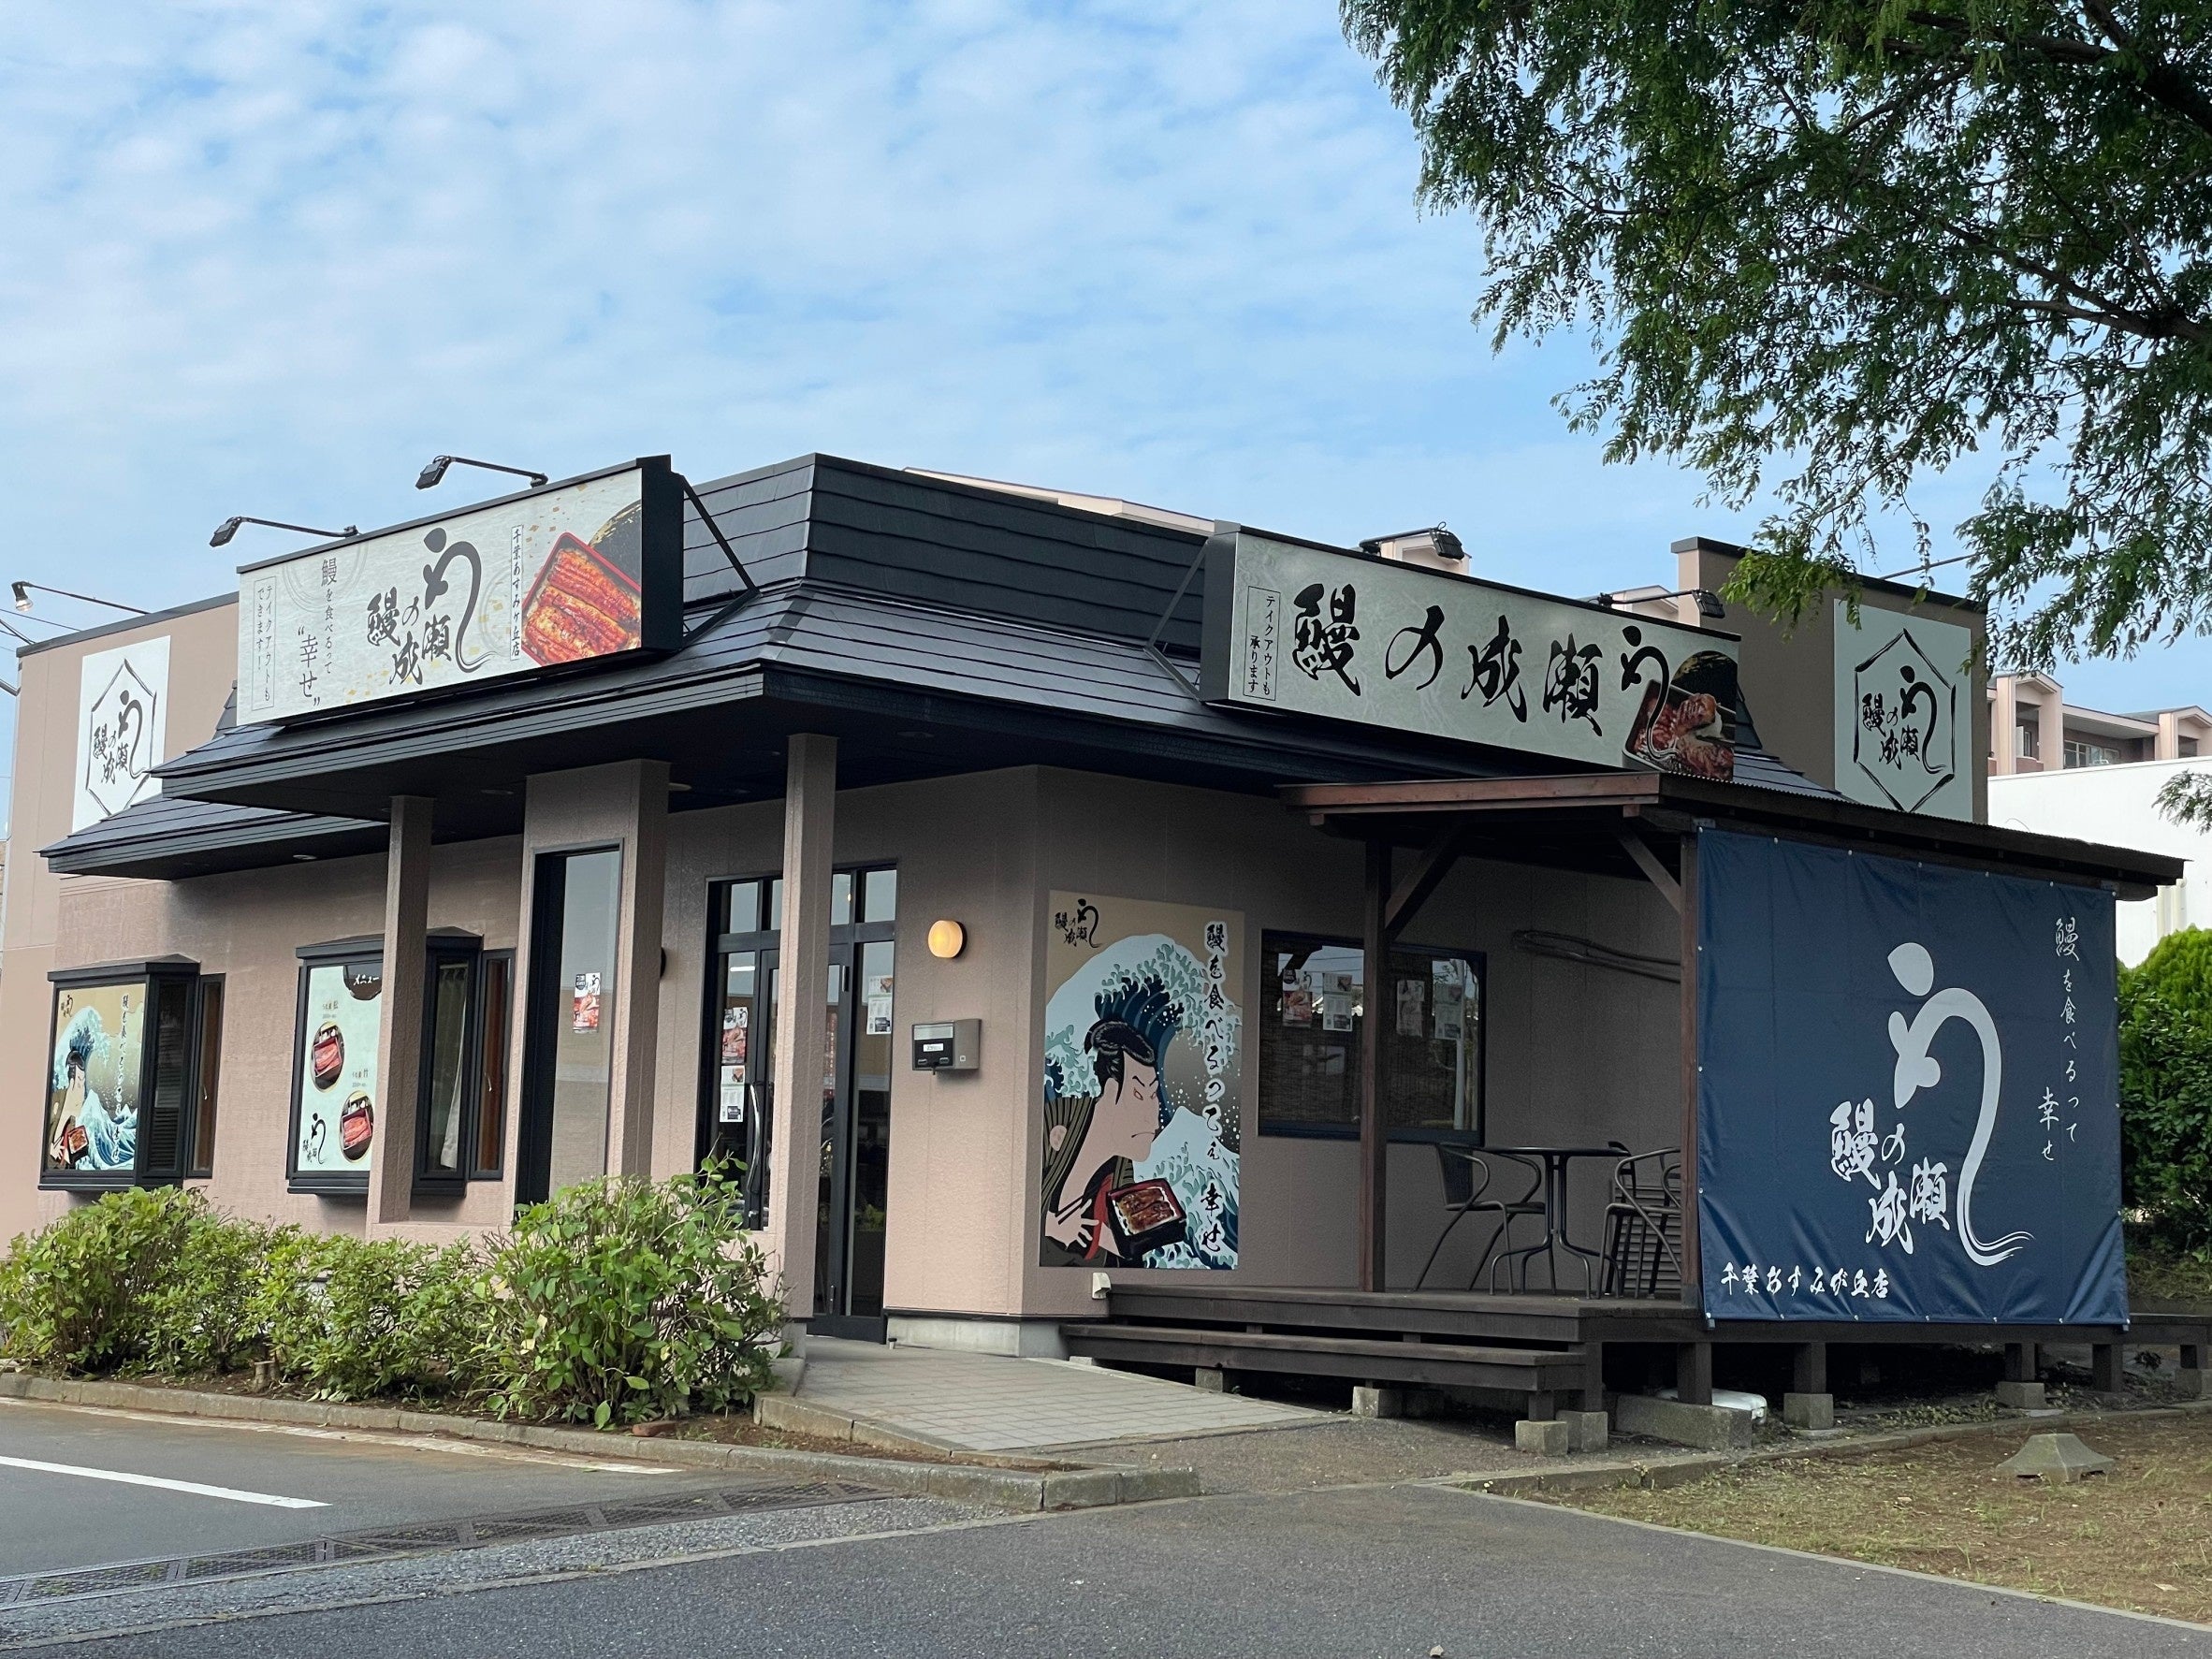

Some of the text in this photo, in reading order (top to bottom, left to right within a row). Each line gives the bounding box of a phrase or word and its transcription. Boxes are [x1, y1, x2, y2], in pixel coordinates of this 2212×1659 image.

[265, 585, 273, 703] テイクアウトも
[1247, 634, 1260, 693] 承ります
[1263, 595, 1275, 696] テイクアウトも
[353, 973, 380, 986] メニュー
[2037, 1086, 2059, 1162] 幸せ
[1720, 1261, 1890, 1299] 千葉あすみが丘店
